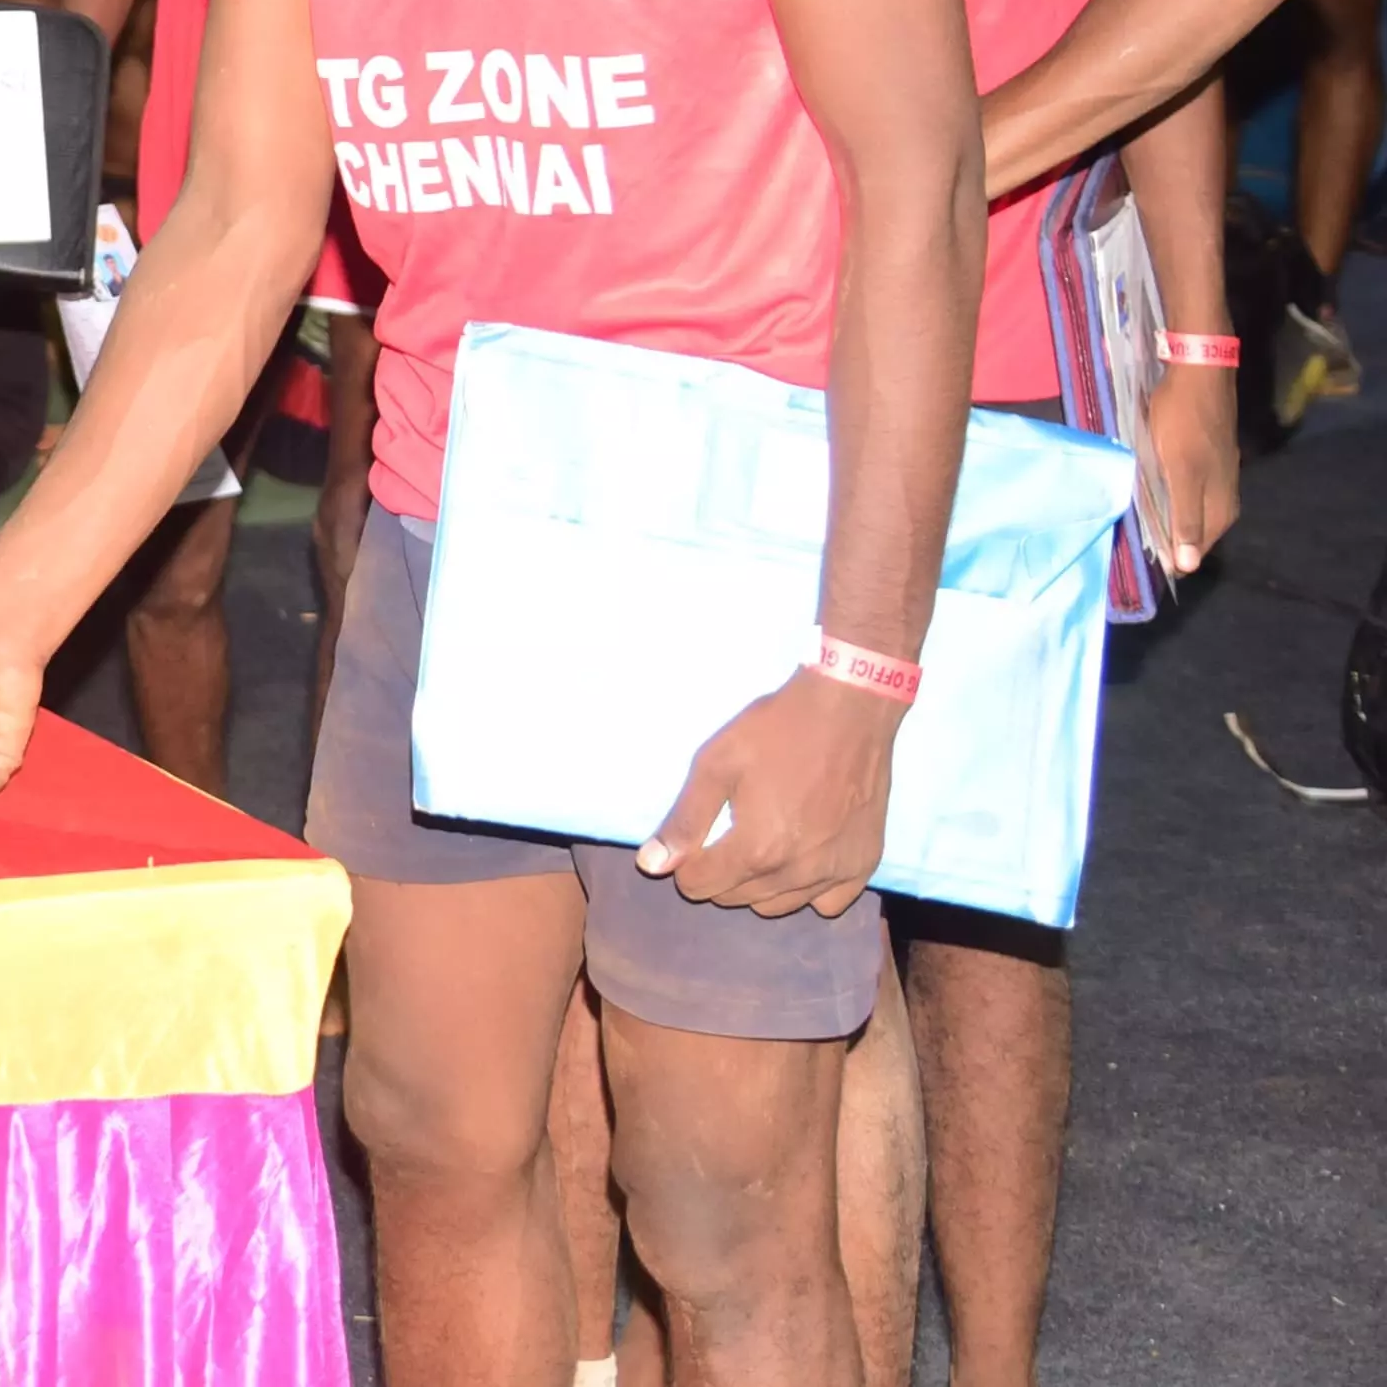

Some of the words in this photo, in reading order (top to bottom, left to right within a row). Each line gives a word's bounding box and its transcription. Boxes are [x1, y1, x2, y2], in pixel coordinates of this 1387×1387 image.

[316, 55, 408, 129] TG
[426, 48, 656, 130] ZONE
[333, 134, 614, 216] CHENNAI
